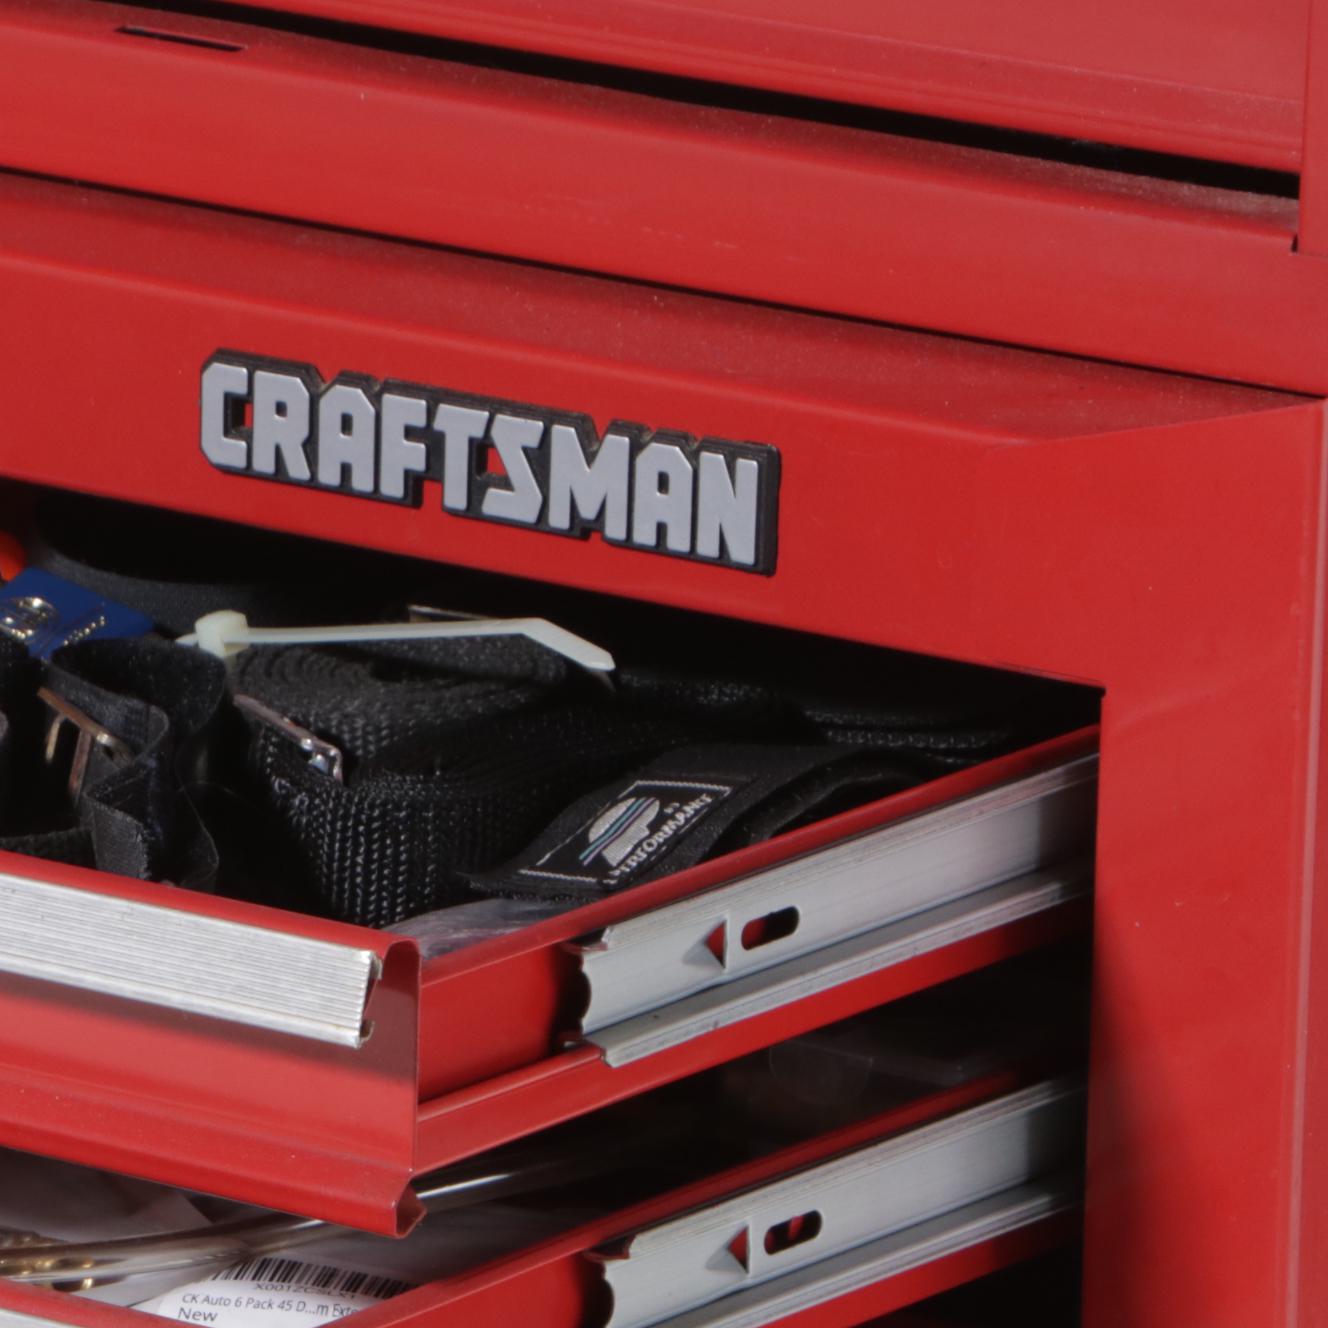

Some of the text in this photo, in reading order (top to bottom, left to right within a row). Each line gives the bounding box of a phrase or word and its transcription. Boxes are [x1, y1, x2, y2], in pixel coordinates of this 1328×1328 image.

[200, 360, 759, 567] CRAFTSMAN
[181, 1292, 199, 1305] CK
[202, 1293, 232, 1308] Auto
[234, 1297, 243, 1309] 6
[245, 1296, 275, 1310] Pack
[278, 1299, 293, 1312] 45
[177, 1307, 219, 1322] New
